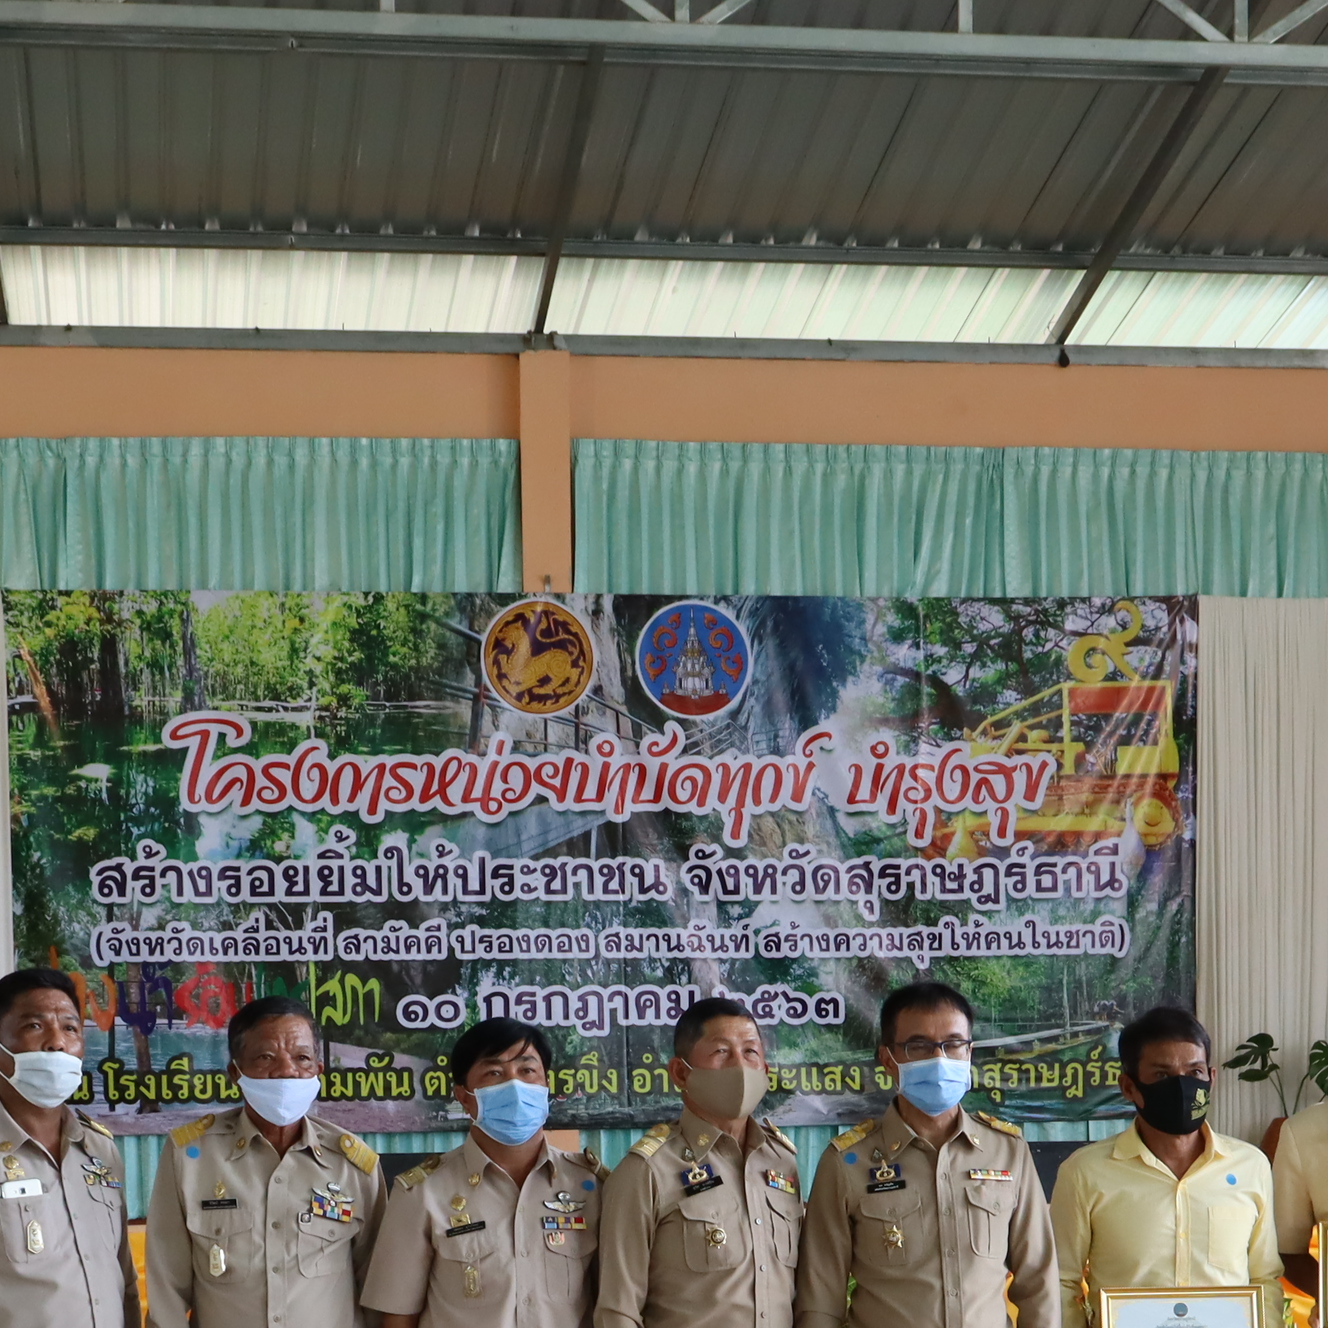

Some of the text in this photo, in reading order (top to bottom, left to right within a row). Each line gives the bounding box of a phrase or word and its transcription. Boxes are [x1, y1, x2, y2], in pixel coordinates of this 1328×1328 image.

[169, 717, 1050, 841] โครงการหน่วยบำบัดทุกข์ บำรุงสุข
[96, 831, 1126, 915] สร้างรอยยิ้มให้ประชาชน จังหวัดสุราษฎร์ธานี
[95, 916, 1126, 965] (จังหวัดเคลื่อนที่ สามัคคี ปรองดอง สมานฉันท์ สร้างความสุขให้คนในชาติ)
[400, 985, 840, 1032] ๑๐ กรกฎาคม ๕๖๓
